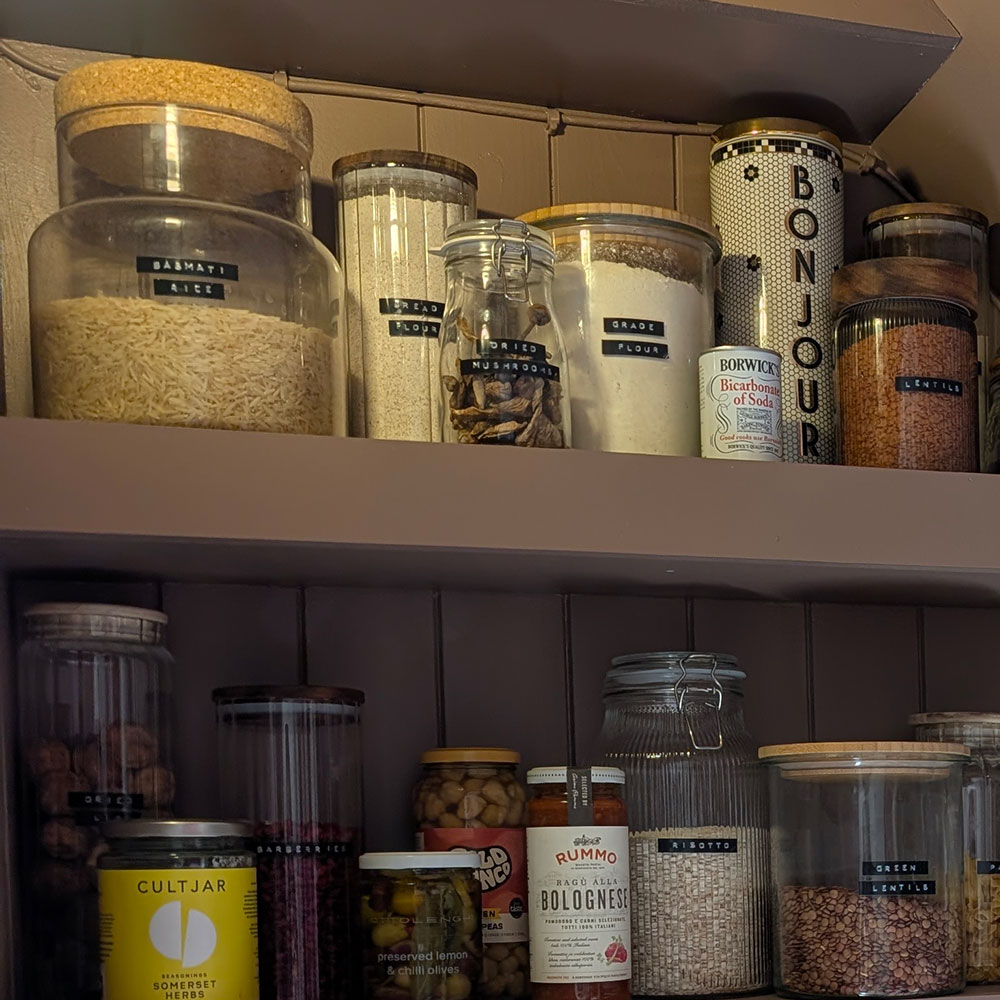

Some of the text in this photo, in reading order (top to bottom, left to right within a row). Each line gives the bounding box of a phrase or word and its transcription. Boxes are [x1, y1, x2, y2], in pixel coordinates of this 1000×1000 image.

[153, 260, 224, 274] BASMATI
[394, 300, 438, 312] BREAD
[786, 167, 822, 457] BONJOUR
[396, 322, 437, 333] FLOUR
[612, 321, 654, 331] GRADE
[490, 342, 536, 353] DRIED
[618, 343, 658, 354] FLOUR
[720, 378, 780, 397] Bicarbonate
[905, 379, 960, 392] LENTILS
[733, 393, 774, 408] of Soda
[672, 841, 729, 849] RISOTTO
[555, 848, 617, 865] RUMMO
[876, 864, 916, 872] GREEN
[137, 880, 226, 893] CULTJAR
[556, 877, 618, 886] RAGÙ ALLA
[872, 883, 928, 892] LENTILS
[541, 888, 628, 911] BOLOGNESE
[377, 951, 468, 963] preserved lemon
[386, 965, 460, 975] & chilli olives
[153, 979, 216, 991] SOMERSET
[165, 990, 205, 1000] HERBS
